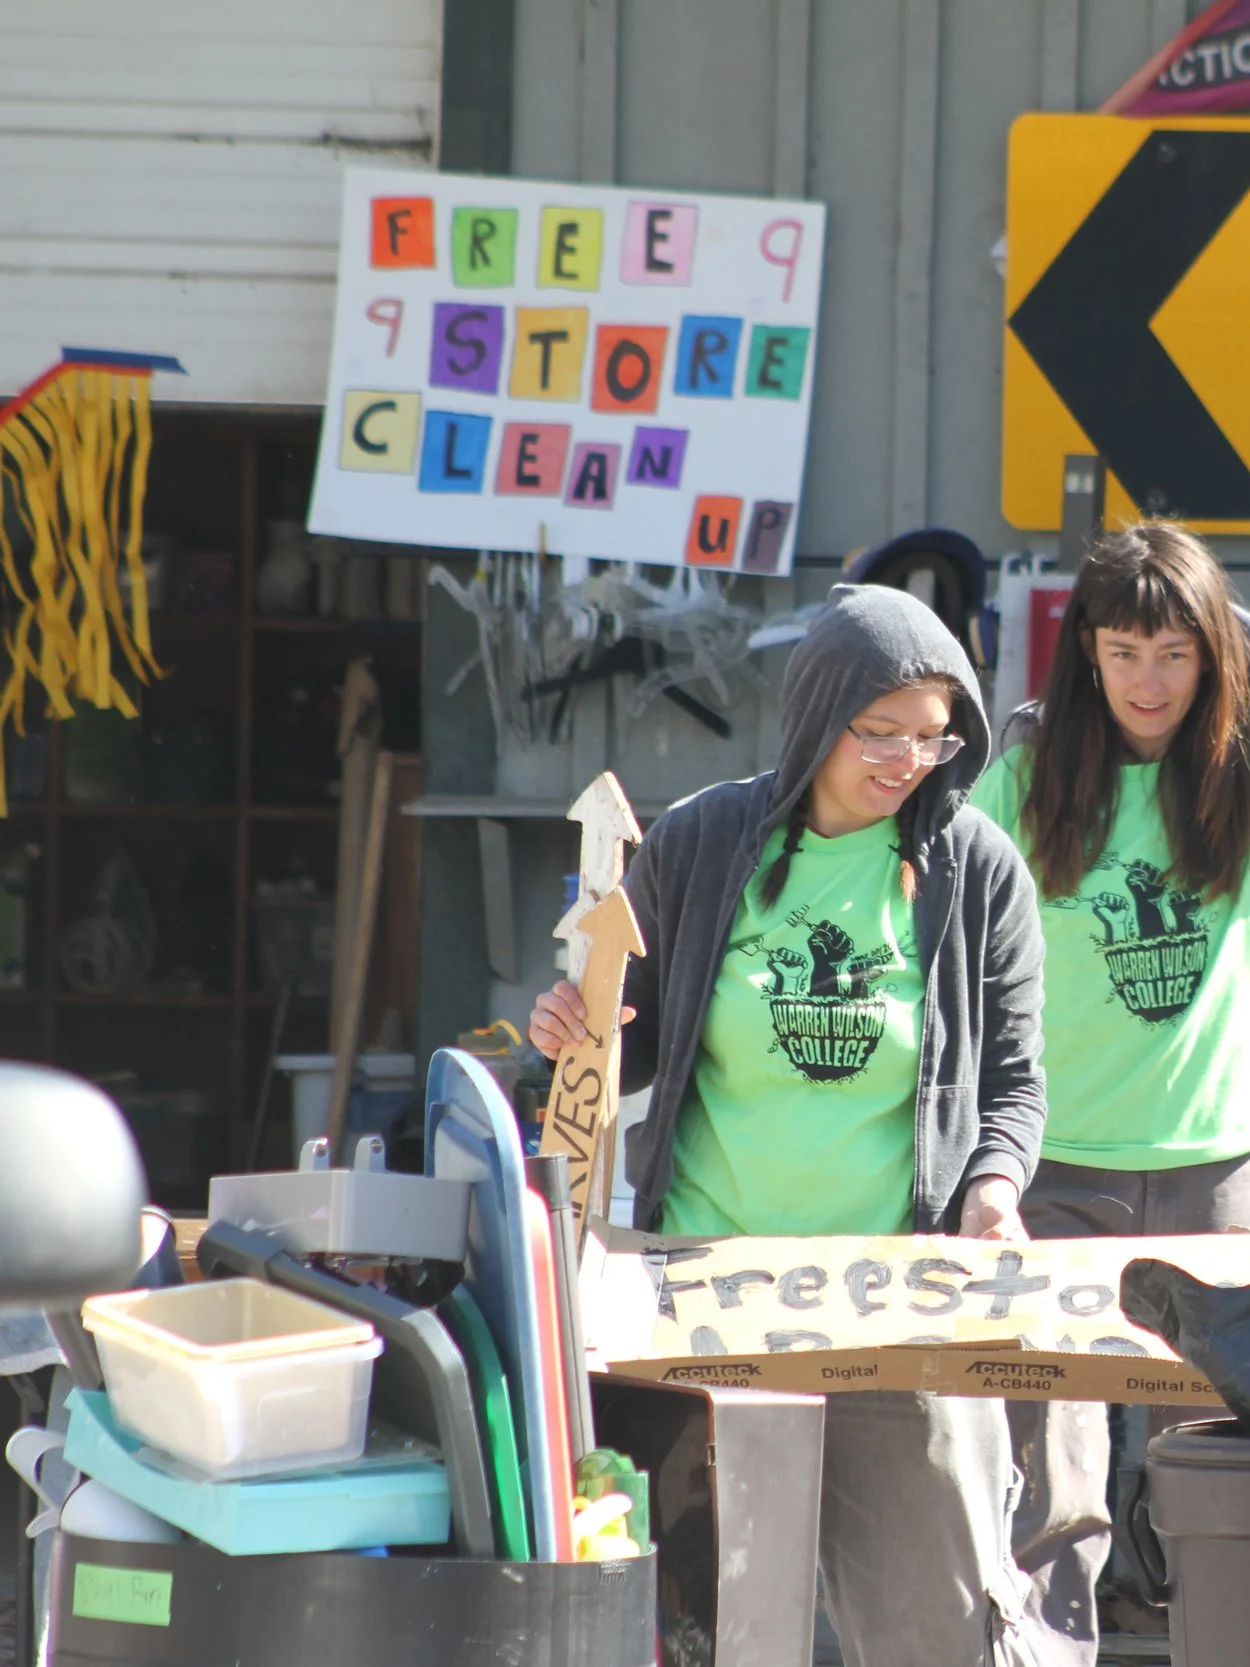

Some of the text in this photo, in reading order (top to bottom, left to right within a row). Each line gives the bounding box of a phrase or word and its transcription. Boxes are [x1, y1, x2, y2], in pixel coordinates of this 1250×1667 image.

[387, 208, 675, 281] FREE
[444, 310, 790, 403] STORE
[352, 400, 673, 501] CLEAN
[1107, 941, 1206, 984] WARREN WILSON
[1123, 976, 1195, 1010] COLLEGE
[772, 1004, 885, 1038] WARREN WILSON
[787, 1036, 870, 1068] COLLEGE
[821, 1364, 878, 1380] Digital
[982, 1377, 1052, 1391] A-CB440
[1126, 1378, 1217, 1393] Digital Sc
